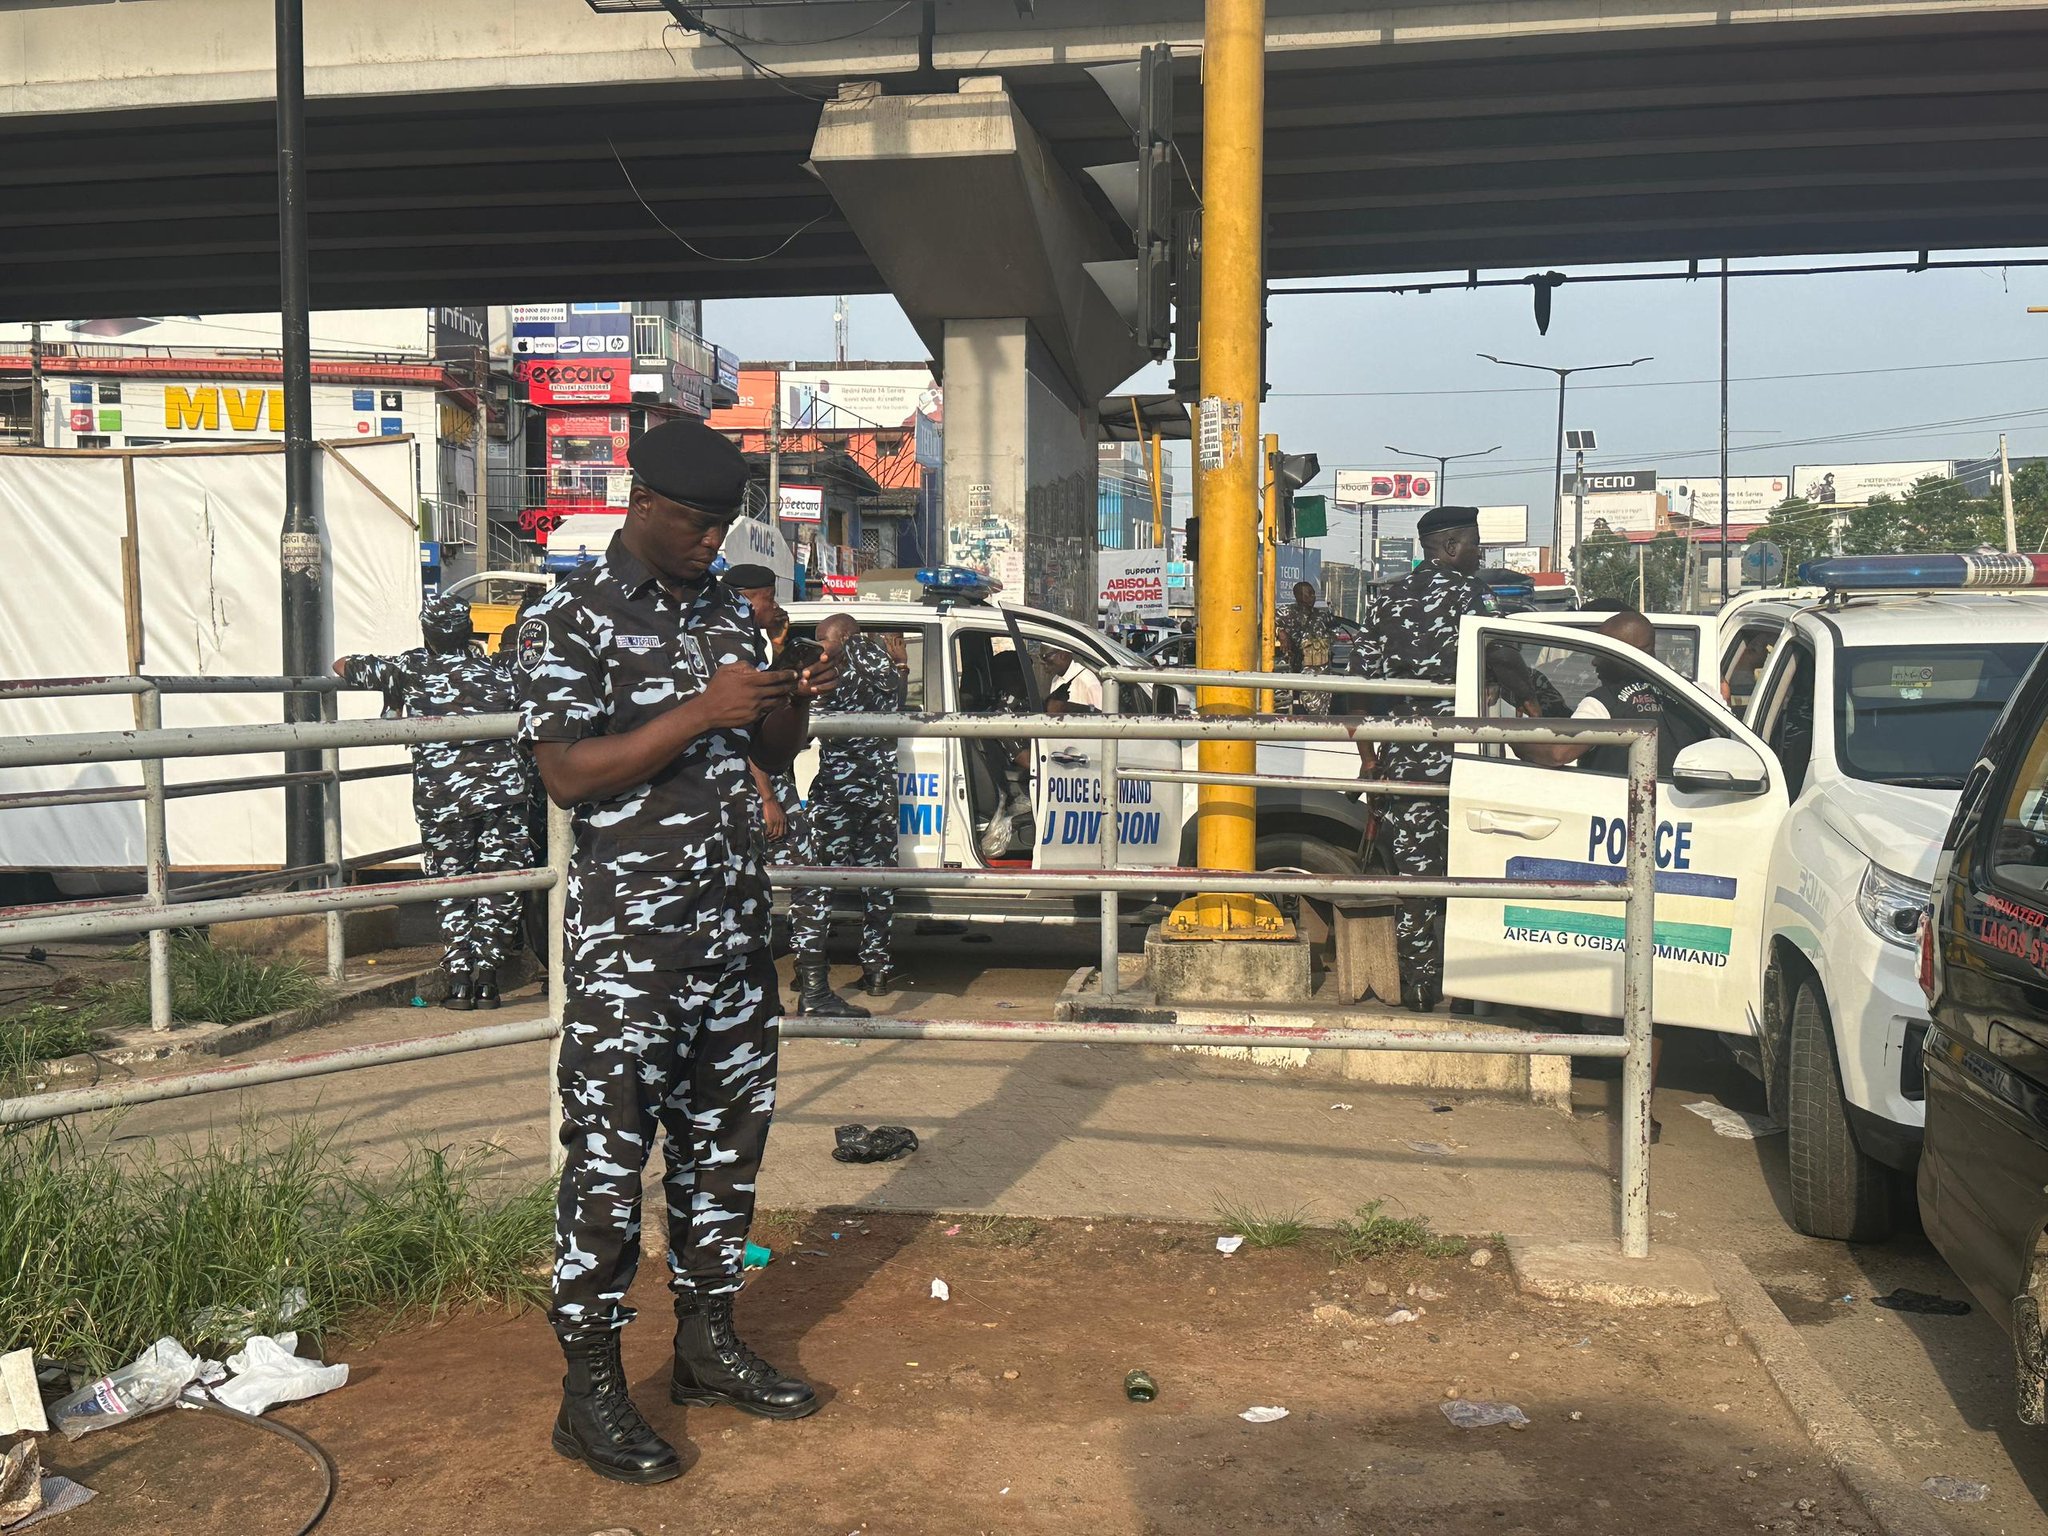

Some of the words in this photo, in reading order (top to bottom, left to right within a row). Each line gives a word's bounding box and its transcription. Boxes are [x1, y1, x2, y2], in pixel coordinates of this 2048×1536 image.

[1584, 475, 1635, 489] TECNO
[749, 524, 775, 557] POLICE
[1107, 576, 1162, 591] ABISOLA
[1047, 777, 1089, 803] POLICE
[1092, 778, 1152, 804] CMAND
[1588, 815, 1692, 870] POCE
[1986, 894, 2045, 928] DONATED
[1503, 926, 1552, 944] AREA
[1556, 931, 1568, 945] G
[1574, 934, 1626, 953] OGBA
[1980, 917, 2027, 958] LAGOS
